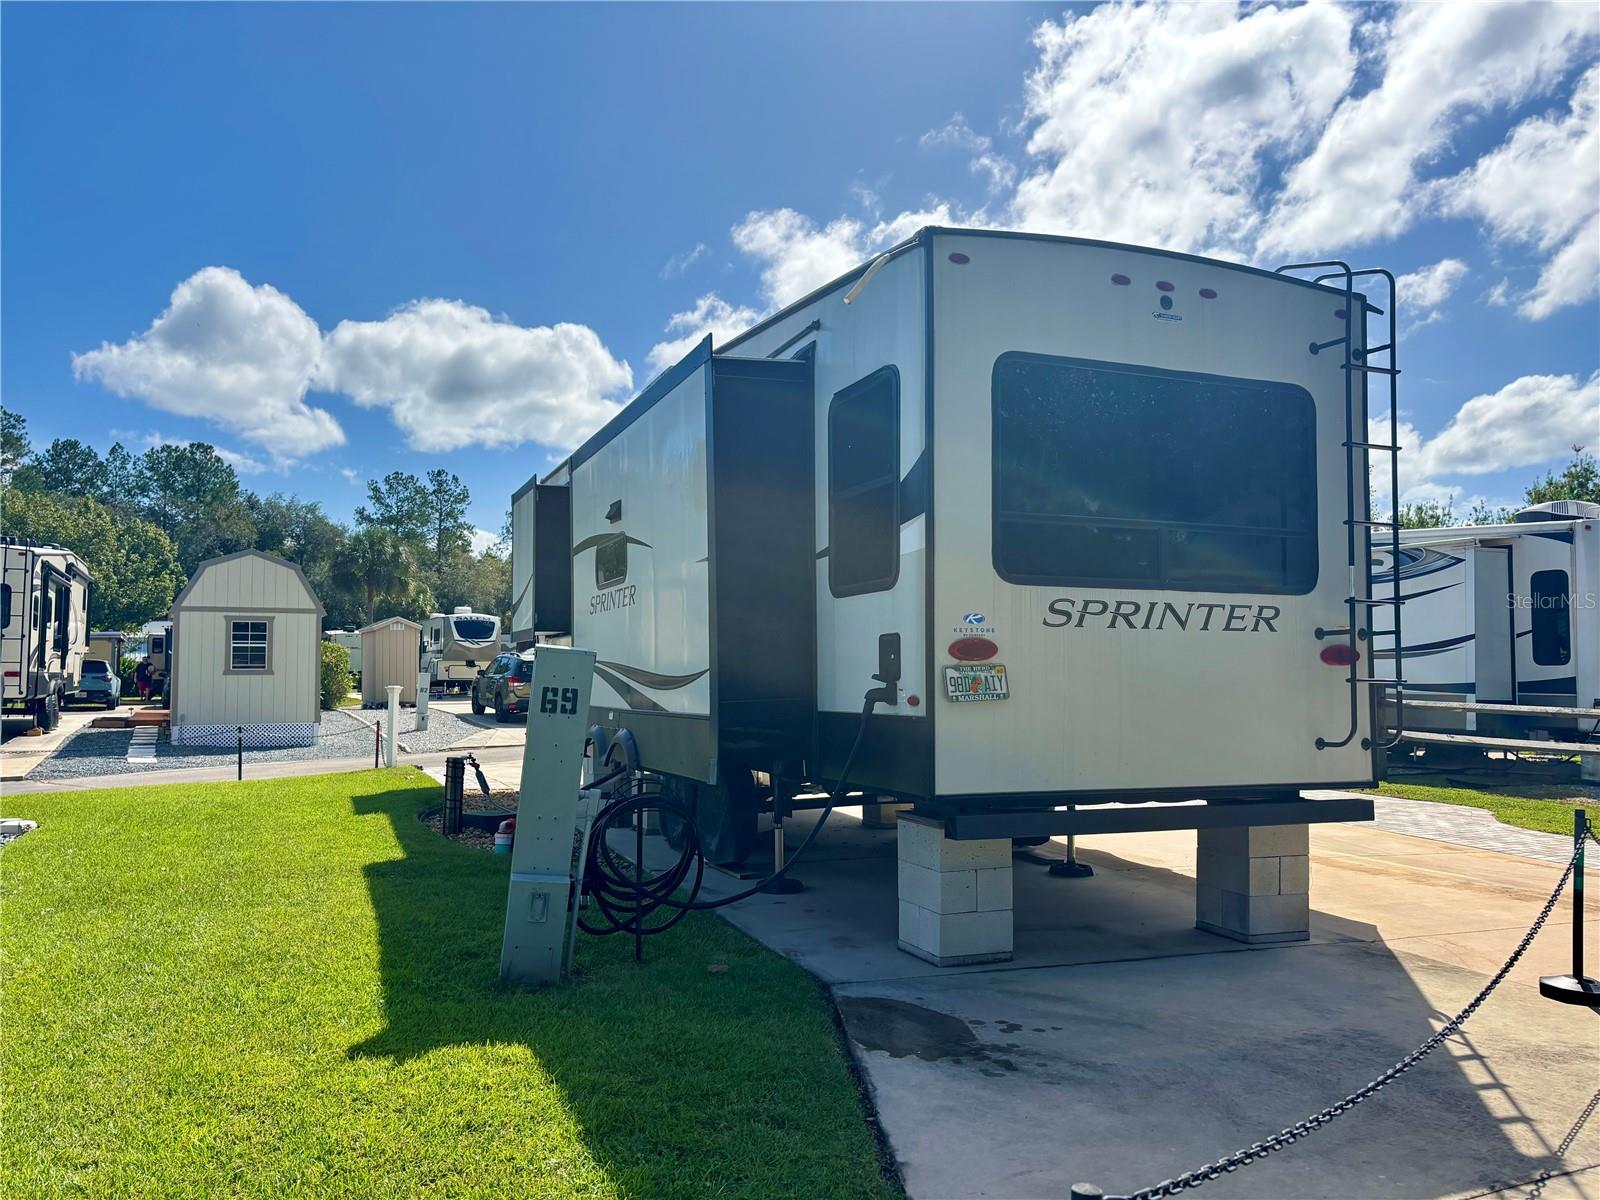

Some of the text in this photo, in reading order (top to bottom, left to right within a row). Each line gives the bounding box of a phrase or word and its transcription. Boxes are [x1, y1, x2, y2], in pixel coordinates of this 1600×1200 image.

[588, 585, 637, 616] SPRINTER
[1042, 598, 1281, 633] SPRINTER
[958, 694, 999, 702] MARSHALL
